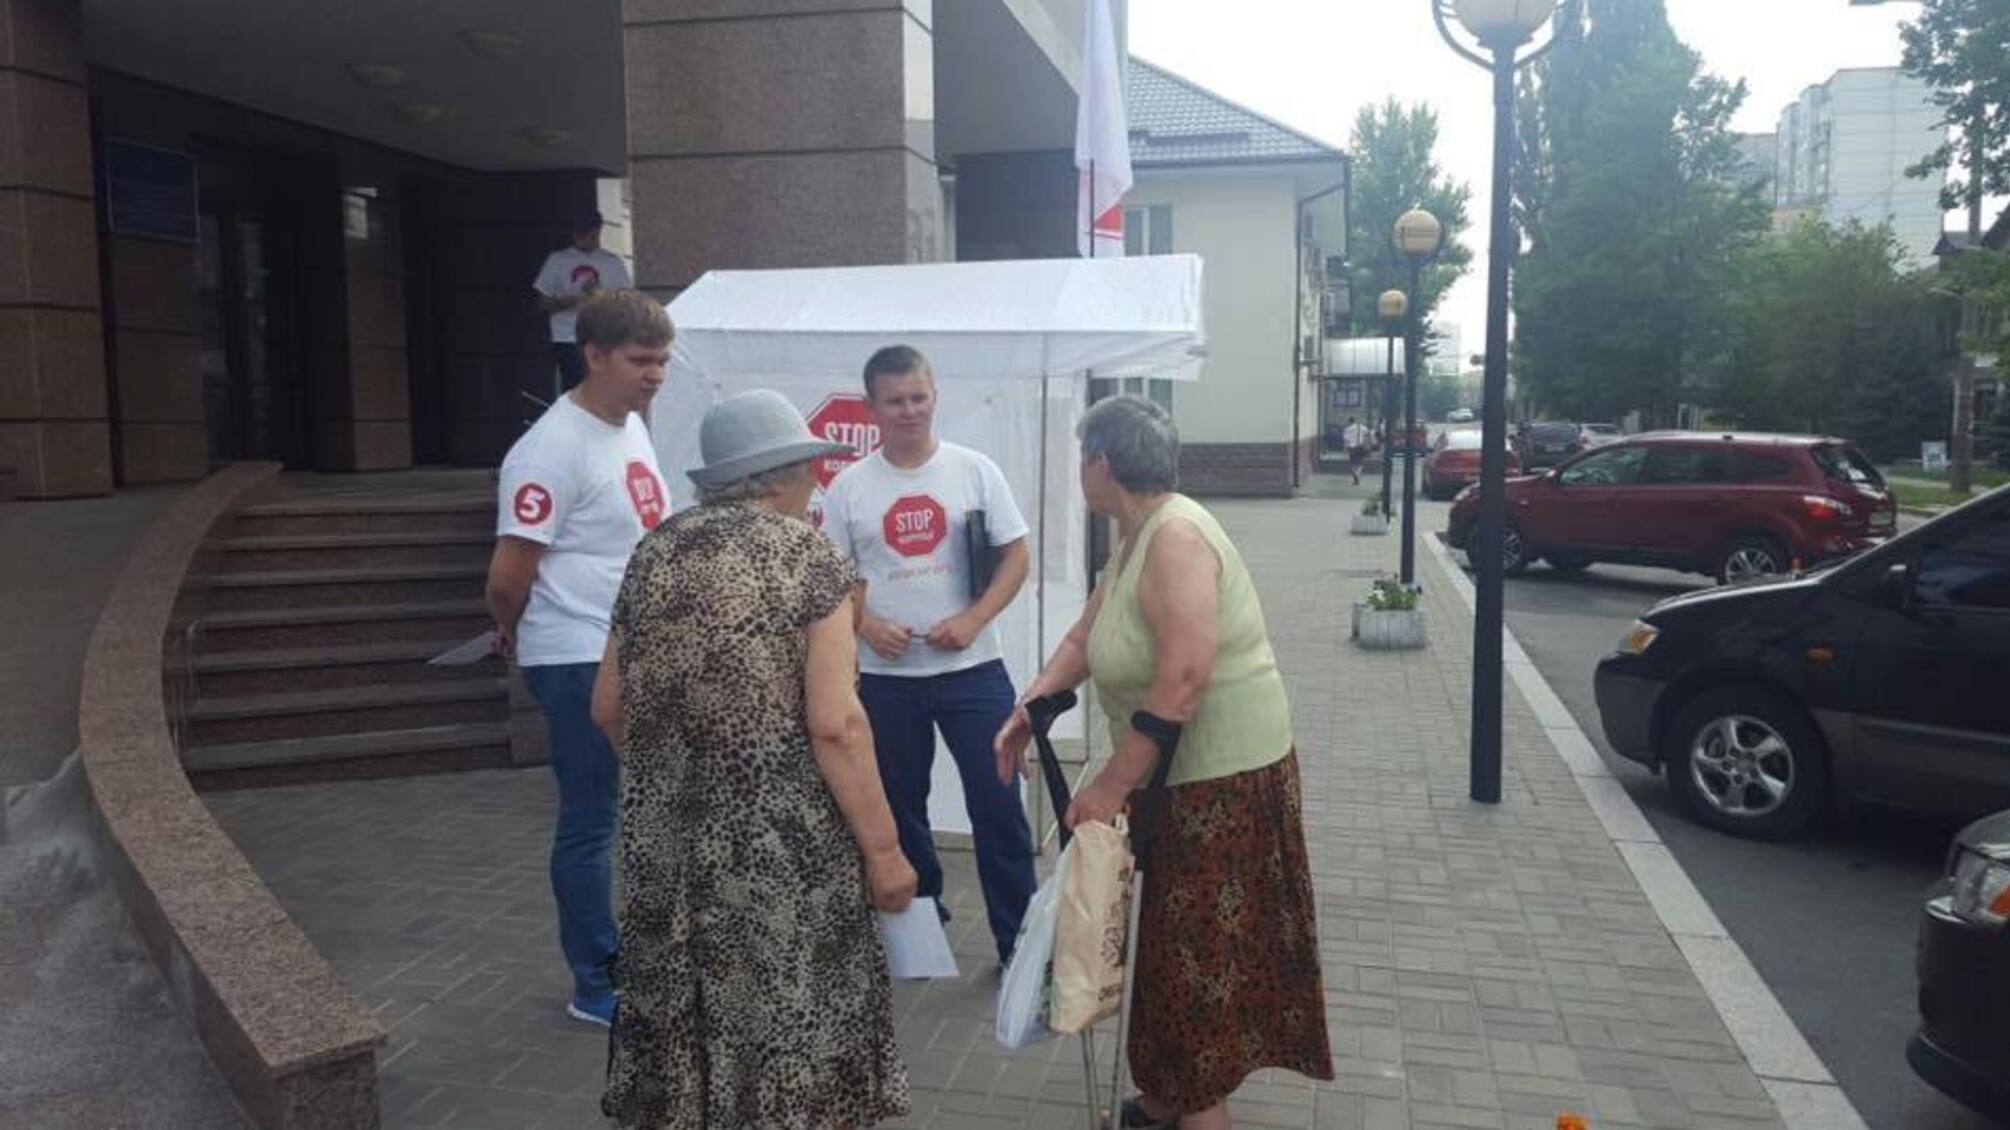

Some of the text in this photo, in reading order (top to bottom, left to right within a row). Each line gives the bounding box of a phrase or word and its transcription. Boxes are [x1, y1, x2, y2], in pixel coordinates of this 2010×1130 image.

[824, 421, 880, 456] STOP
[519, 488, 546, 519] 5
[895, 508, 934, 532] STOP
